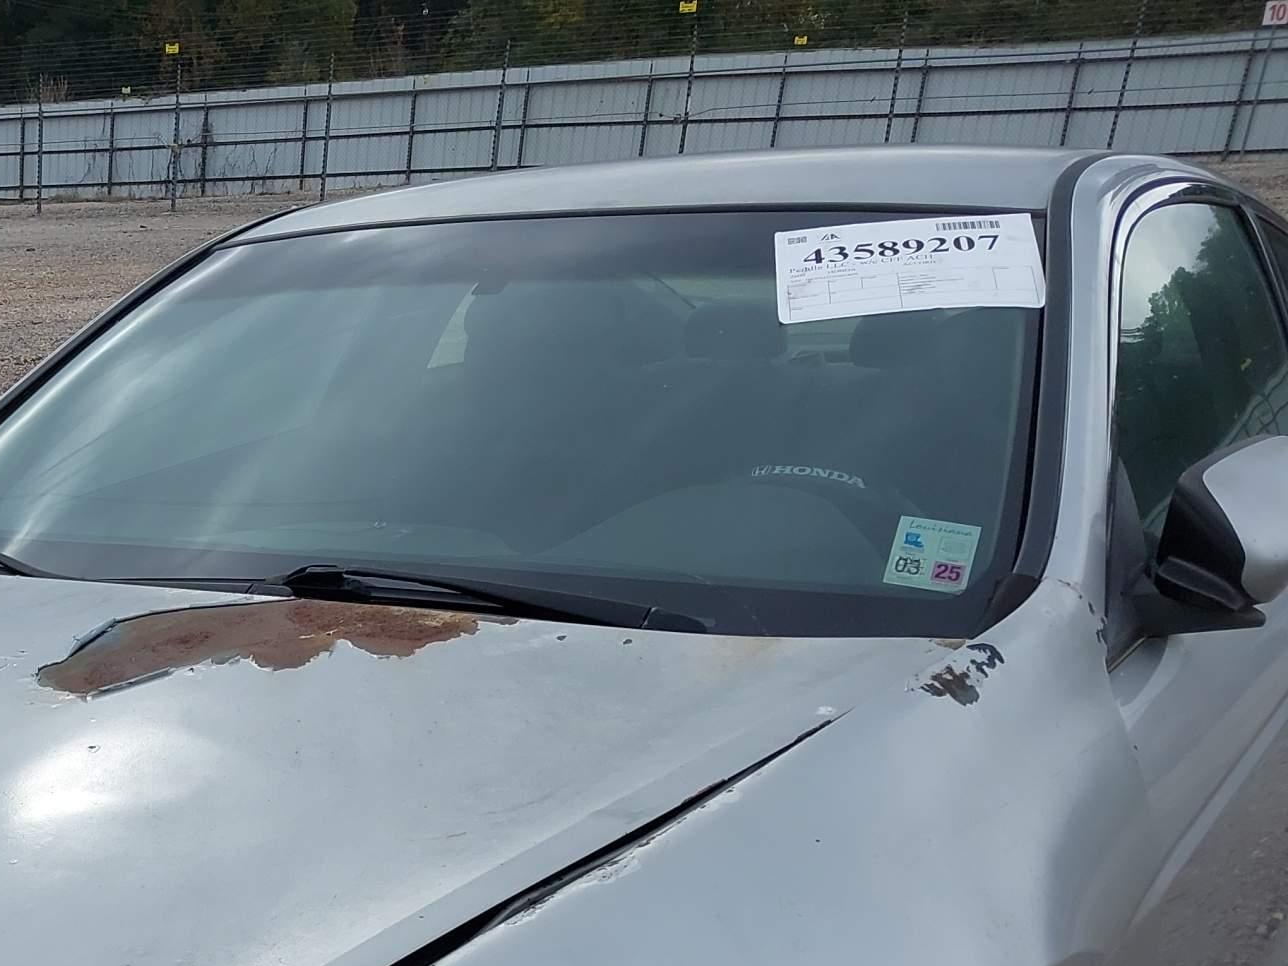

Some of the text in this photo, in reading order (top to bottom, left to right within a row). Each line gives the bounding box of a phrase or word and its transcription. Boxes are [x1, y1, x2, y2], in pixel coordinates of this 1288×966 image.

[1268, 3, 1287, 22] 10
[802, 234, 1000, 264] 43589207
[772, 465, 866, 489] HONDA
[934, 563, 962, 582] 25
